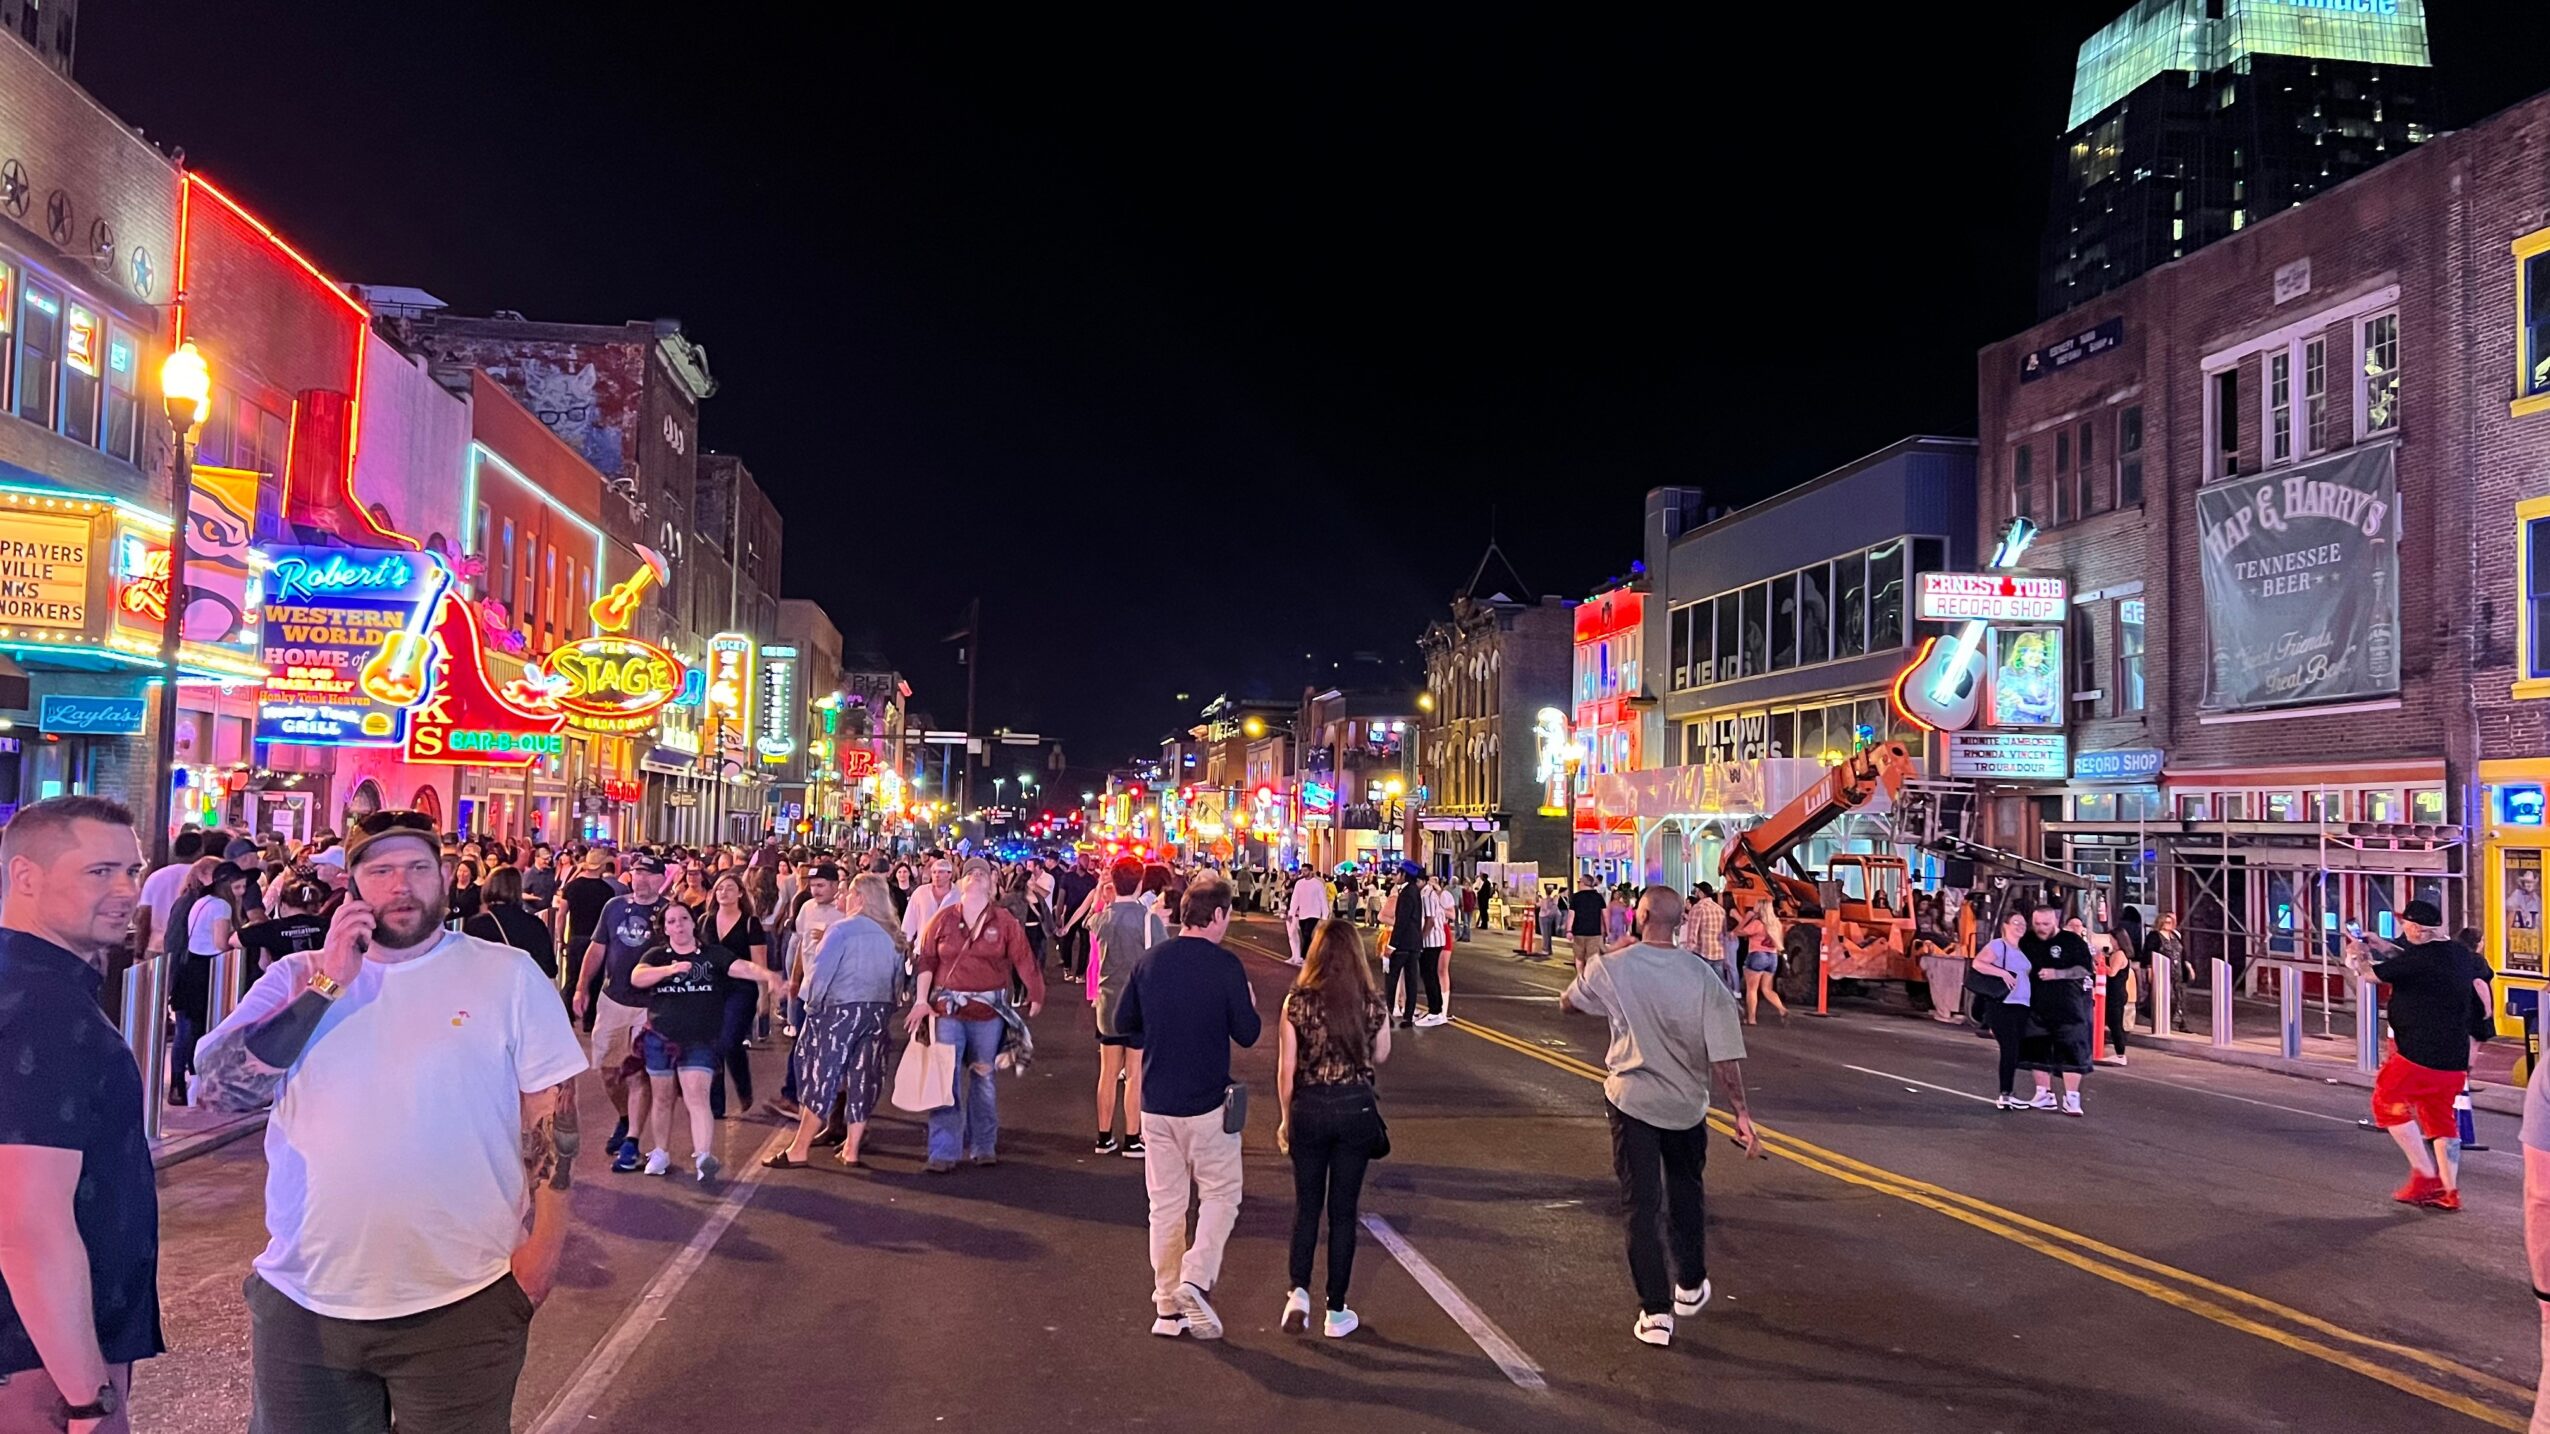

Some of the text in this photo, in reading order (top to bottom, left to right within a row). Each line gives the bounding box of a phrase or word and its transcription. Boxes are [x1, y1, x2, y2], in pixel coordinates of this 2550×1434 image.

[2205, 476, 2388, 563] HAP & HARRY'S
[1, 541, 83, 562] PRAYERS
[2235, 543, 2341, 580] TENNESSEE
[273, 555, 411, 602] Robert's
[1926, 575, 2063, 597] ERNEST TUBB
[2262, 572, 2311, 597] BEER
[264, 604, 405, 628] WESTERN
[1937, 598, 2053, 617] RECORD SHOP
[282, 625, 384, 645] WORLD
[713, 641, 748, 652] LUCKY
[264, 648, 370, 672] HOME of
[552, 648, 673, 698] STAGE
[259, 690, 371, 706] Honky Tonk Heaven
[47, 705, 139, 728] Layla's
[583, 714, 654, 731] BROADWAY
[281, 720, 342, 736] GRILL
[450, 731, 562, 753] BAR-B-QUE
[1960, 736, 2000, 746] MIDNITE
[1963, 749, 2054, 760] RHONDA VINCENT
[2074, 754, 2157, 773] RECORD SHOP
[1974, 762, 2046, 773] TROUBADOUR
